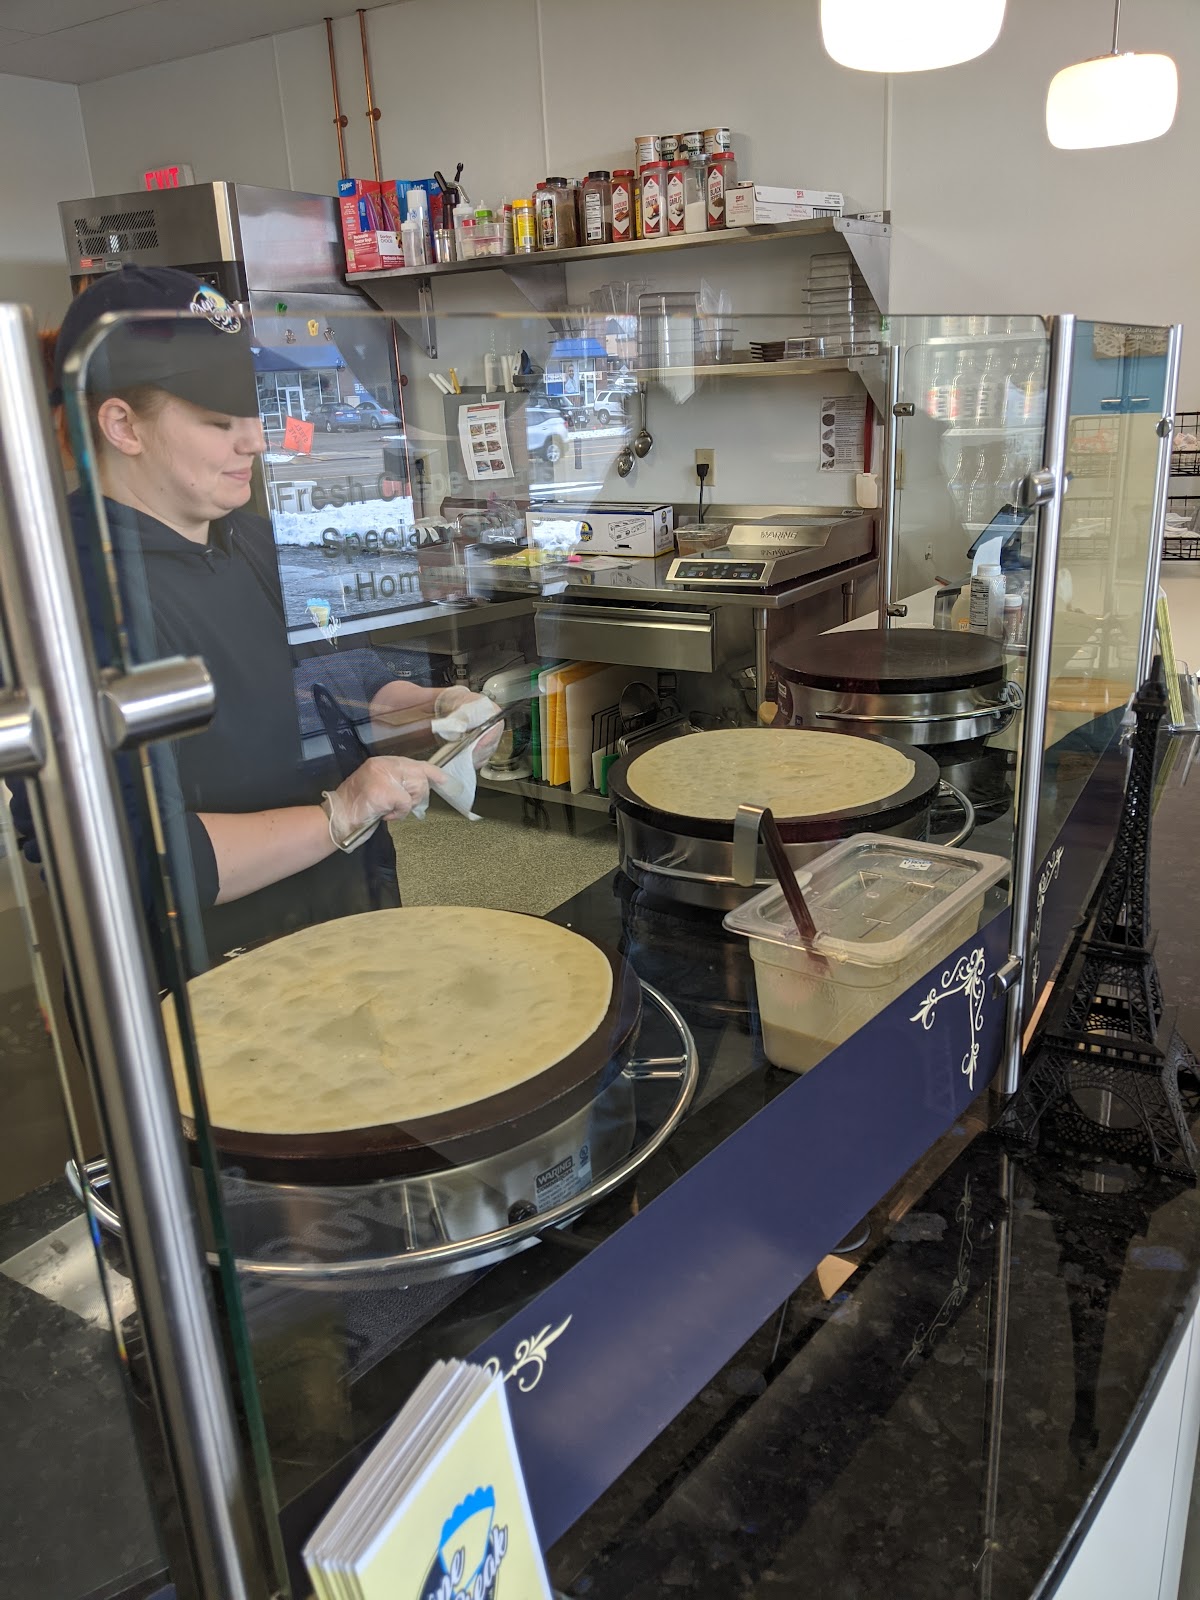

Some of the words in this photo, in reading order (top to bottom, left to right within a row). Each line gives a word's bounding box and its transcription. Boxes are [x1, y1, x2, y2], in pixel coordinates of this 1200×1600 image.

[275, 475, 368, 514] Fresh
[760, 531, 798, 541] WARING
[537, 1158, 573, 1185] WARING
